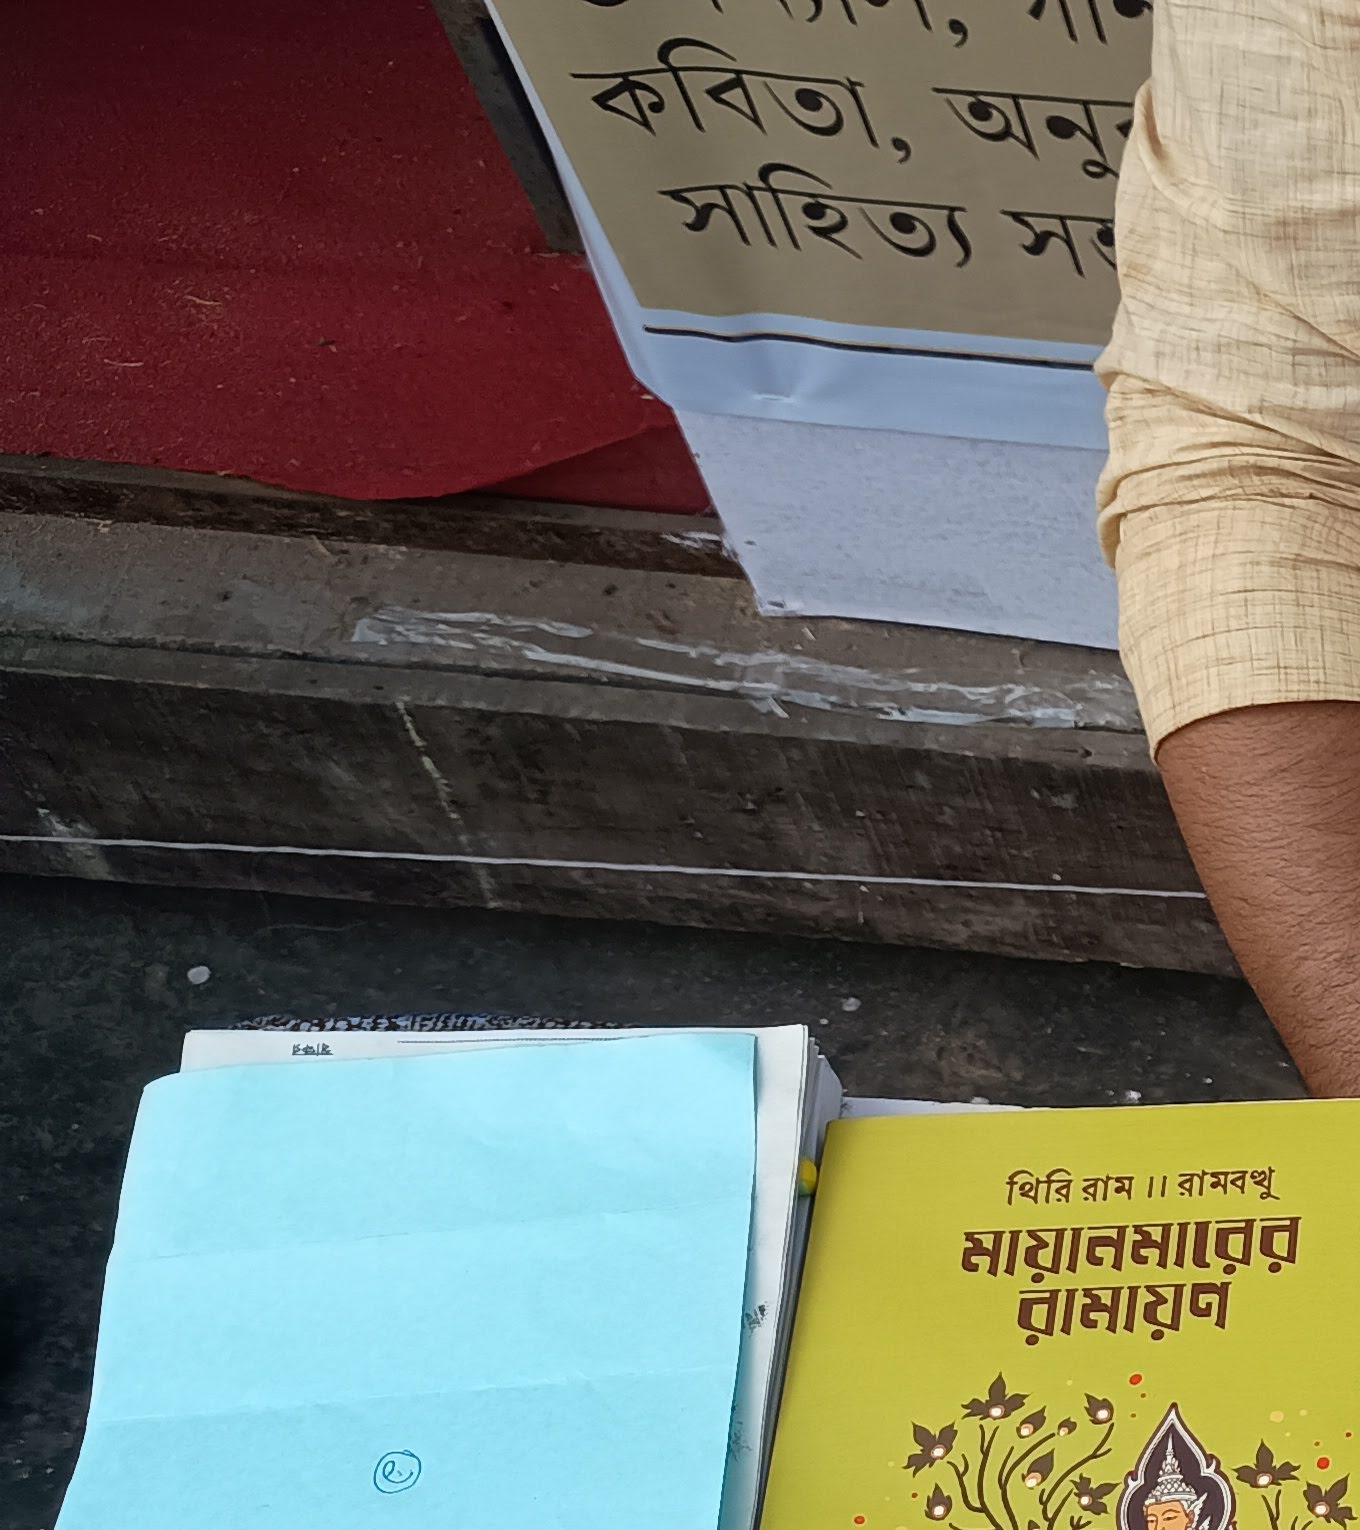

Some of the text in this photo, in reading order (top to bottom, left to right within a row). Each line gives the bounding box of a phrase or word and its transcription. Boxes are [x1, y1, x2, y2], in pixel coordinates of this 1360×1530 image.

[570, 37, 912, 163] কবিতা,
[658, 163, 971, 268] সাহিত্য
[1005, 1168, 1072, 1205] থিরি
[1082, 1173, 1134, 1202] রাম
[960, 1216, 1302, 1284] মায়ানমারের
[1016, 1281, 1232, 1346] রামায়ণ
